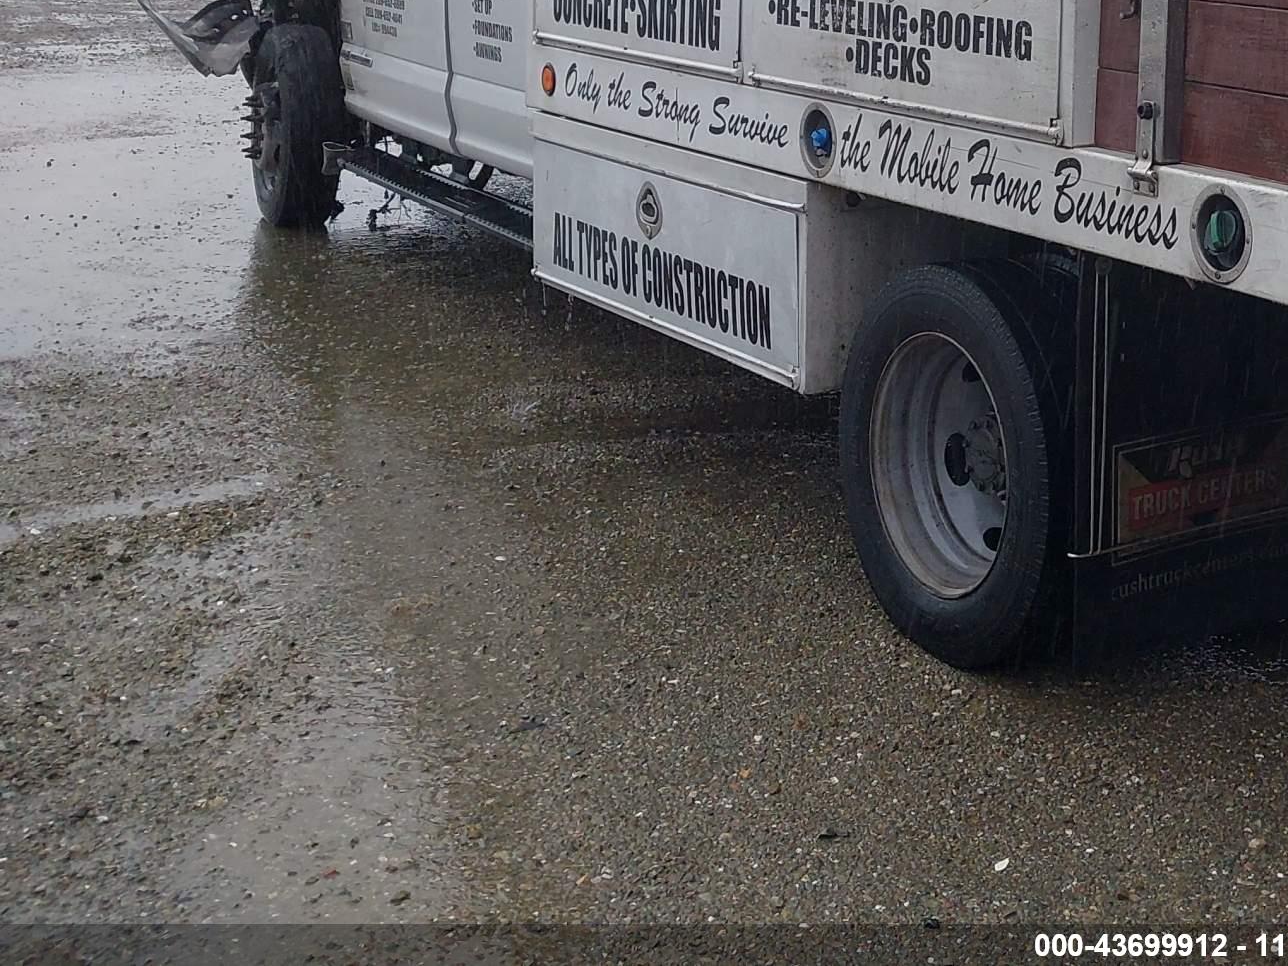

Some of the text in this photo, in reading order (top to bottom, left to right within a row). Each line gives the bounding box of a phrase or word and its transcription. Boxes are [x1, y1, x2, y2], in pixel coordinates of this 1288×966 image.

[484, 0, 493, 15] UP
[474, 19, 513, 43] FOUNDATIONS
[919, 8, 1033, 62] ROOFING
[475, 42, 502, 63] AWNINGS
[565, 62, 1179, 250] Only the Strong Survive the Mobile Home Business
[553, 211, 772, 350] ALL TYPES OF CONSTRUCTION
[1132, 484, 1191, 522] TRUCK
